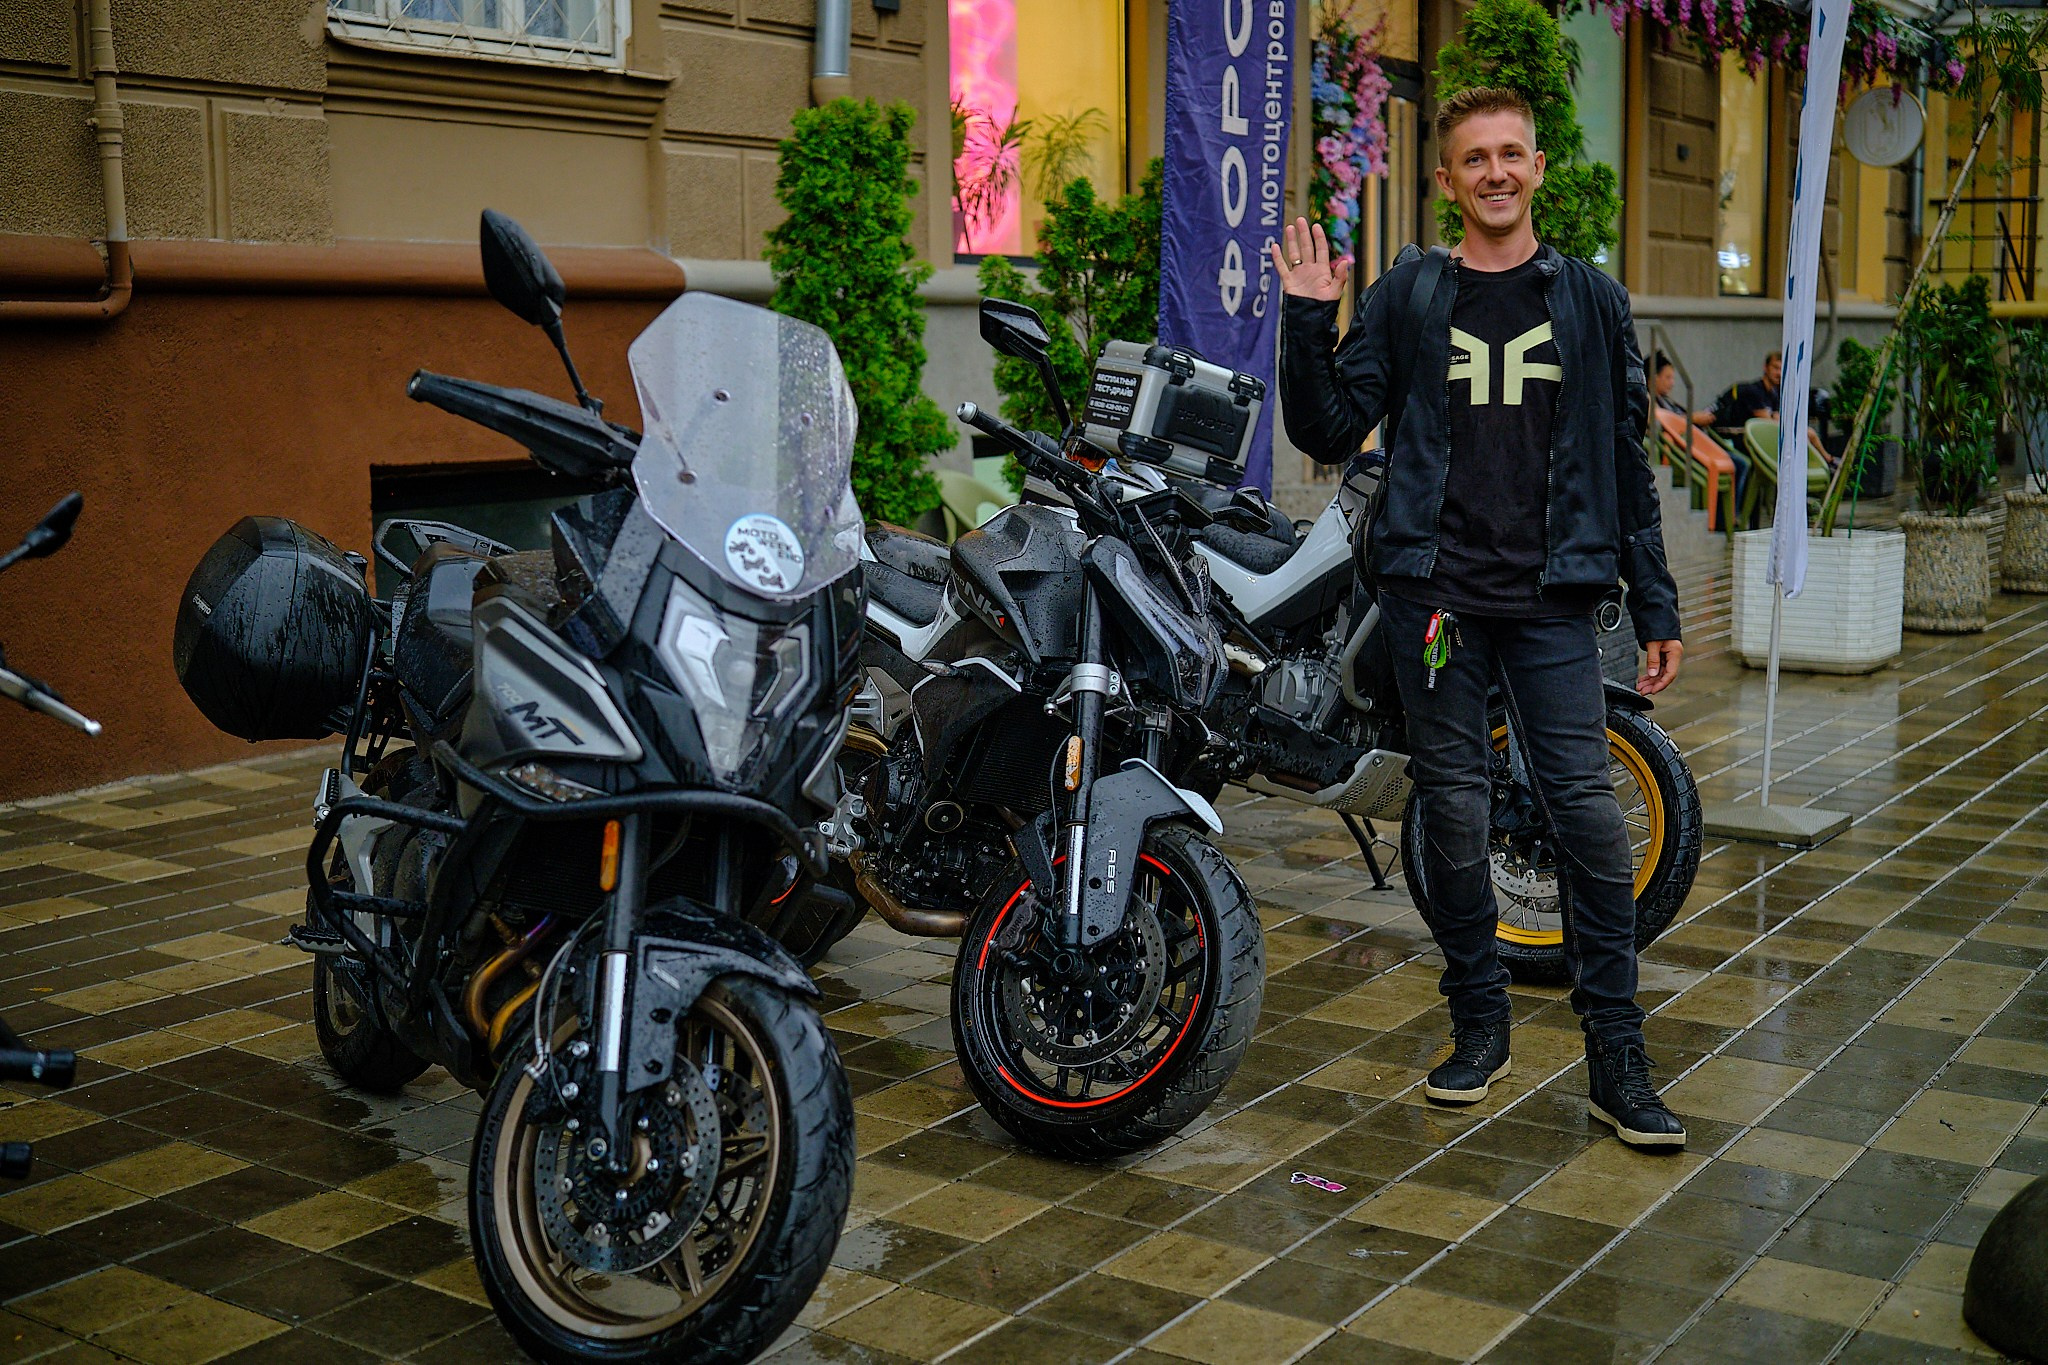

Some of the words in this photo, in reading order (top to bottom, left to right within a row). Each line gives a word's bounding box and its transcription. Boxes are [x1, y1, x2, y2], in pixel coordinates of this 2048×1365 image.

[1252, 235, 1276, 318] Сеть
[1094, 383, 1134, 397] ТЕСТ-ДРАЙВ
[1096, 373, 1137, 387] БЕСПЛАТНЫЙ
[737, 527, 779, 541] MOTO
[964, 581, 1005, 629] NK
[504, 701, 585, 746] MT
[1107, 849, 1117, 894] ABS
